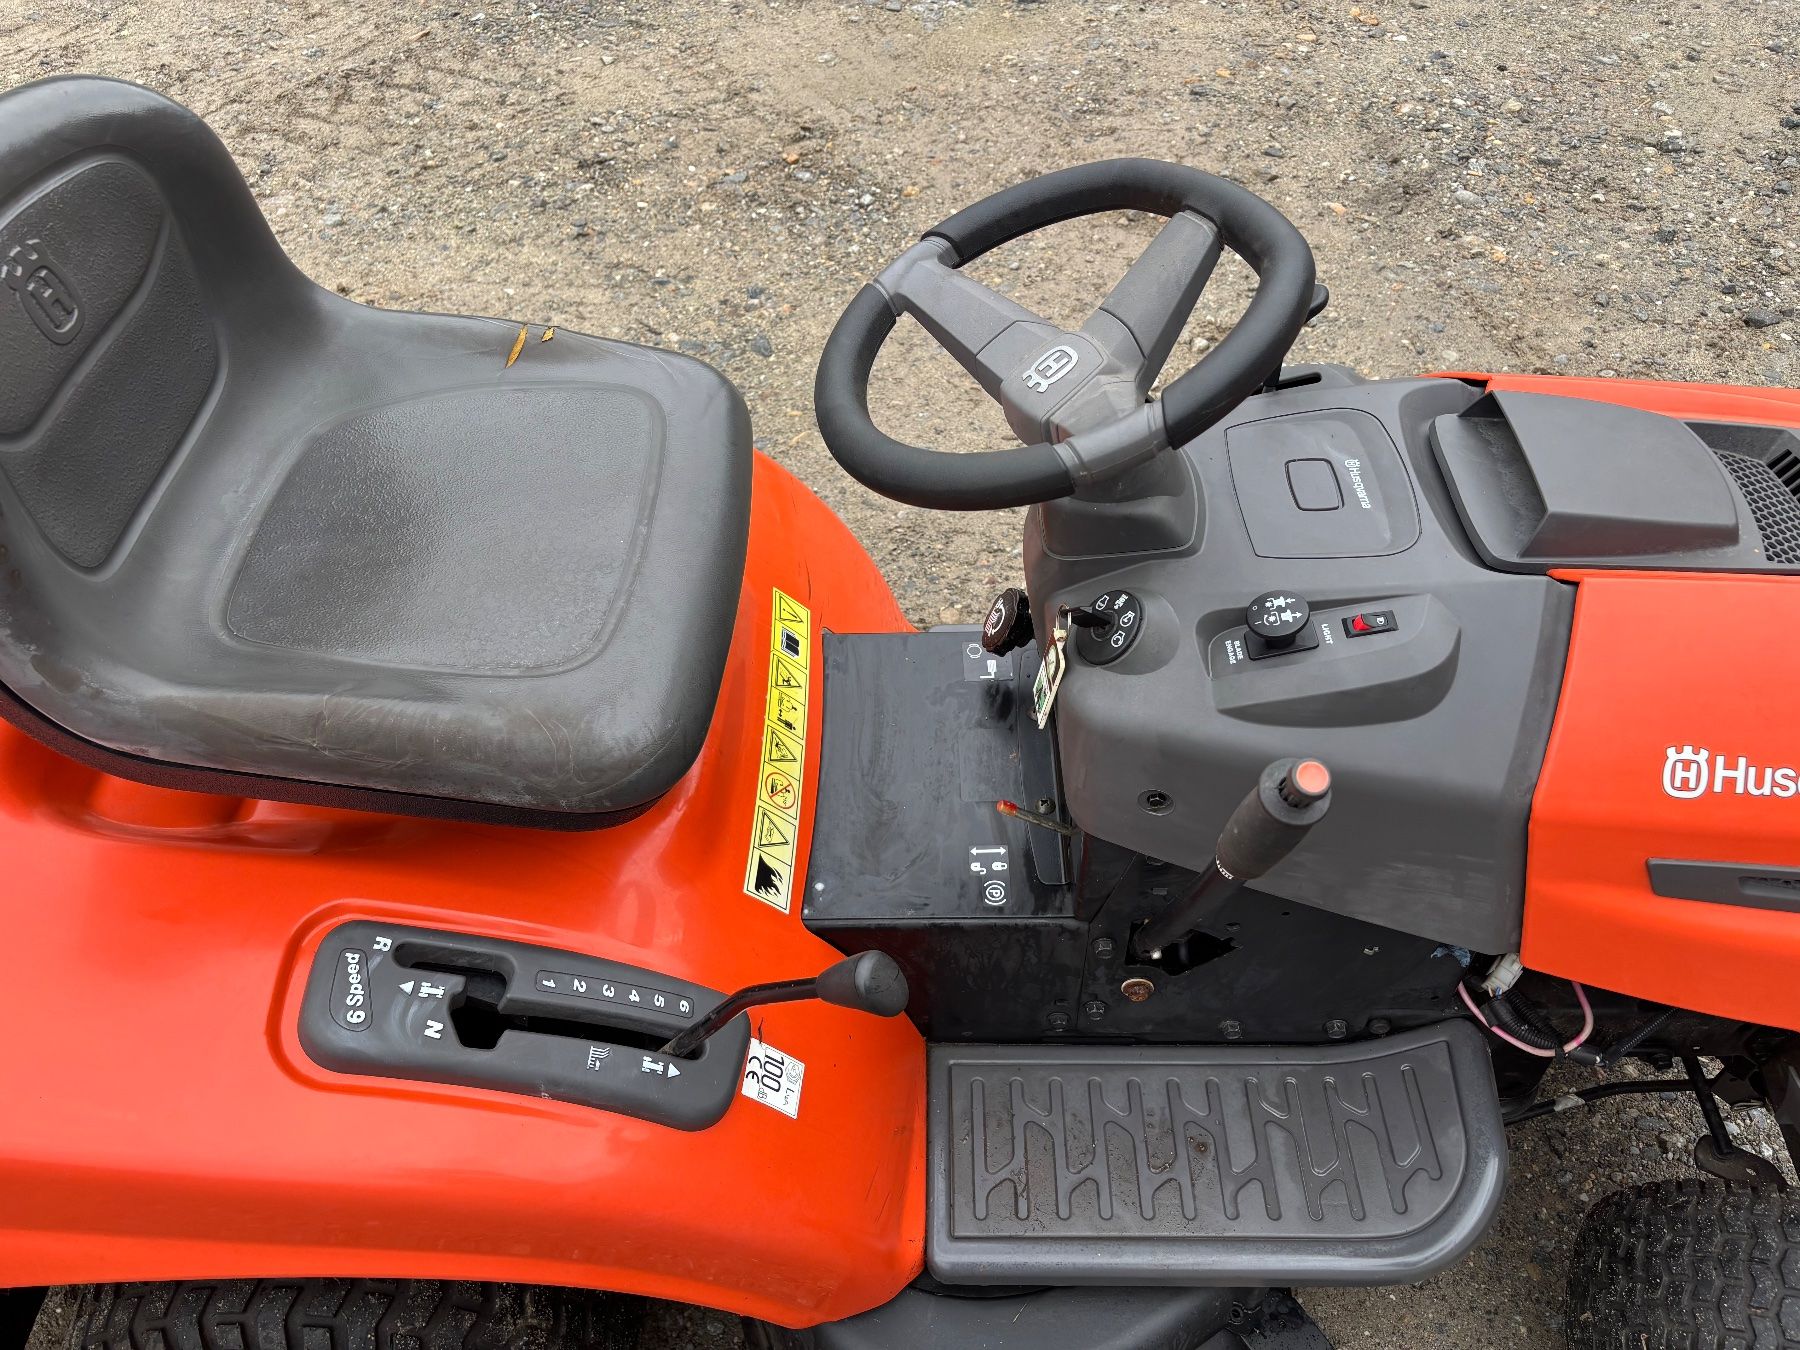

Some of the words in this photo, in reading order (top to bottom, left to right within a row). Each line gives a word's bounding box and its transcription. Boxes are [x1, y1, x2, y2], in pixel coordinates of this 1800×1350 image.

[1348, 467, 1371, 509] Husqvarna
[1321, 623, 1334, 645] LIGHT
[1233, 640, 1244, 660] BLADE
[1713, 755, 1800, 798] Hus
[373, 936, 393, 952] R
[345, 952, 365, 1007] Speed
[542, 978, 556, 988] 1
[573, 978, 587, 993] 2
[602, 983, 615, 998] 3
[628, 989, 641, 1003] 4
[653, 993, 665, 1008] 5
[679, 999, 690, 1014] 6
[346, 1009, 366, 1024] 6
[423, 1019, 444, 1040] N
[745, 1055, 763, 1085] CE
[760, 1054, 785, 1093] 100
